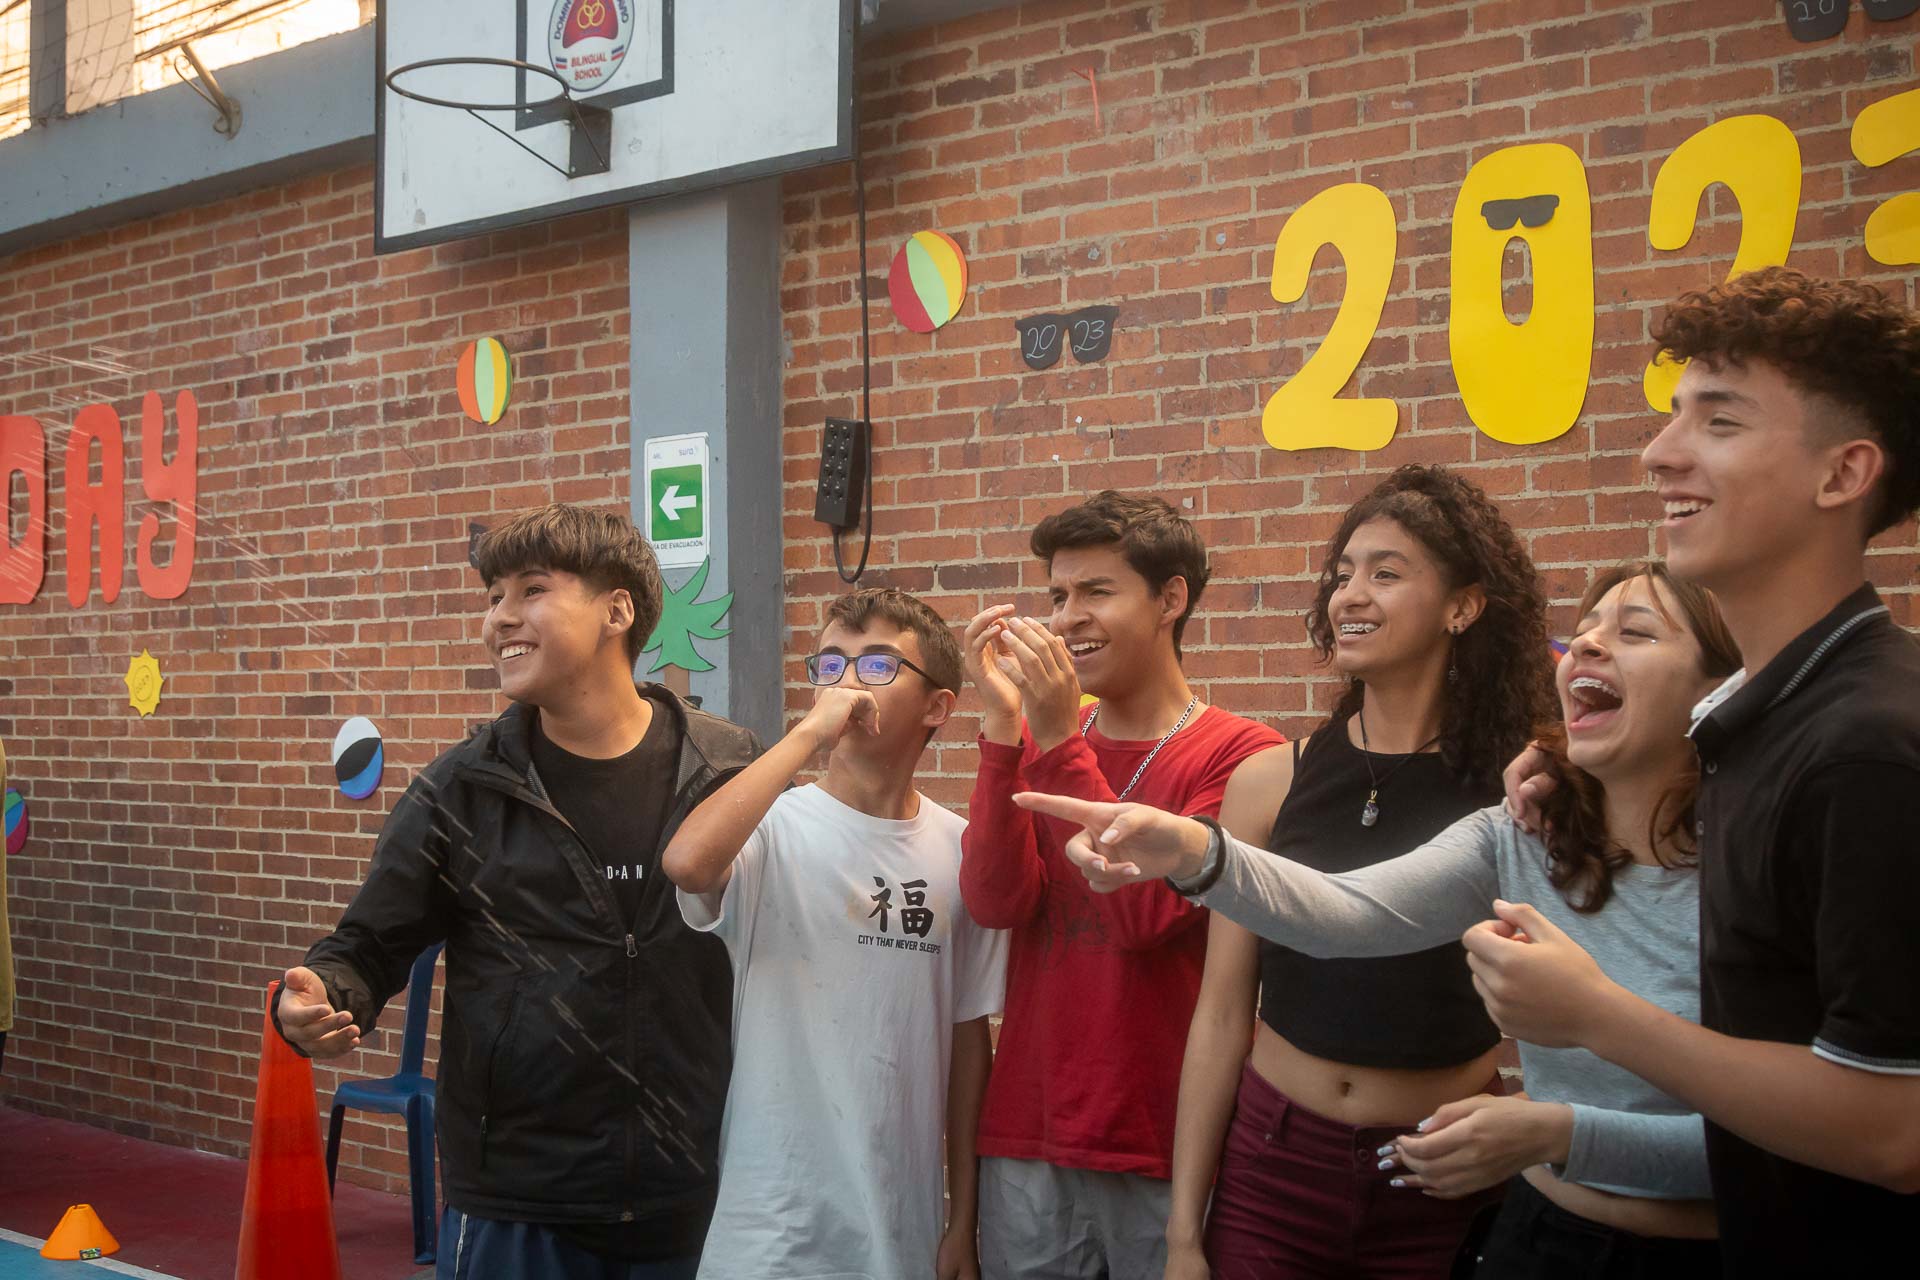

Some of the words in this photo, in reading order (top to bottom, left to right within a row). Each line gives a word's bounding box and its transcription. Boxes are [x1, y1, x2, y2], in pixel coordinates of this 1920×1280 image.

[571, 52, 607, 68] BILINGUAL
[575, 67, 602, 81] SCHOOL
[661, 542, 668, 550] DE
[868, 876, 934, 938] 福
[858, 934, 874, 946] CITY
[876, 936, 894, 948] THAT
[895, 939, 918, 951] NEVER
[919, 942, 942, 954] SLEEPS
